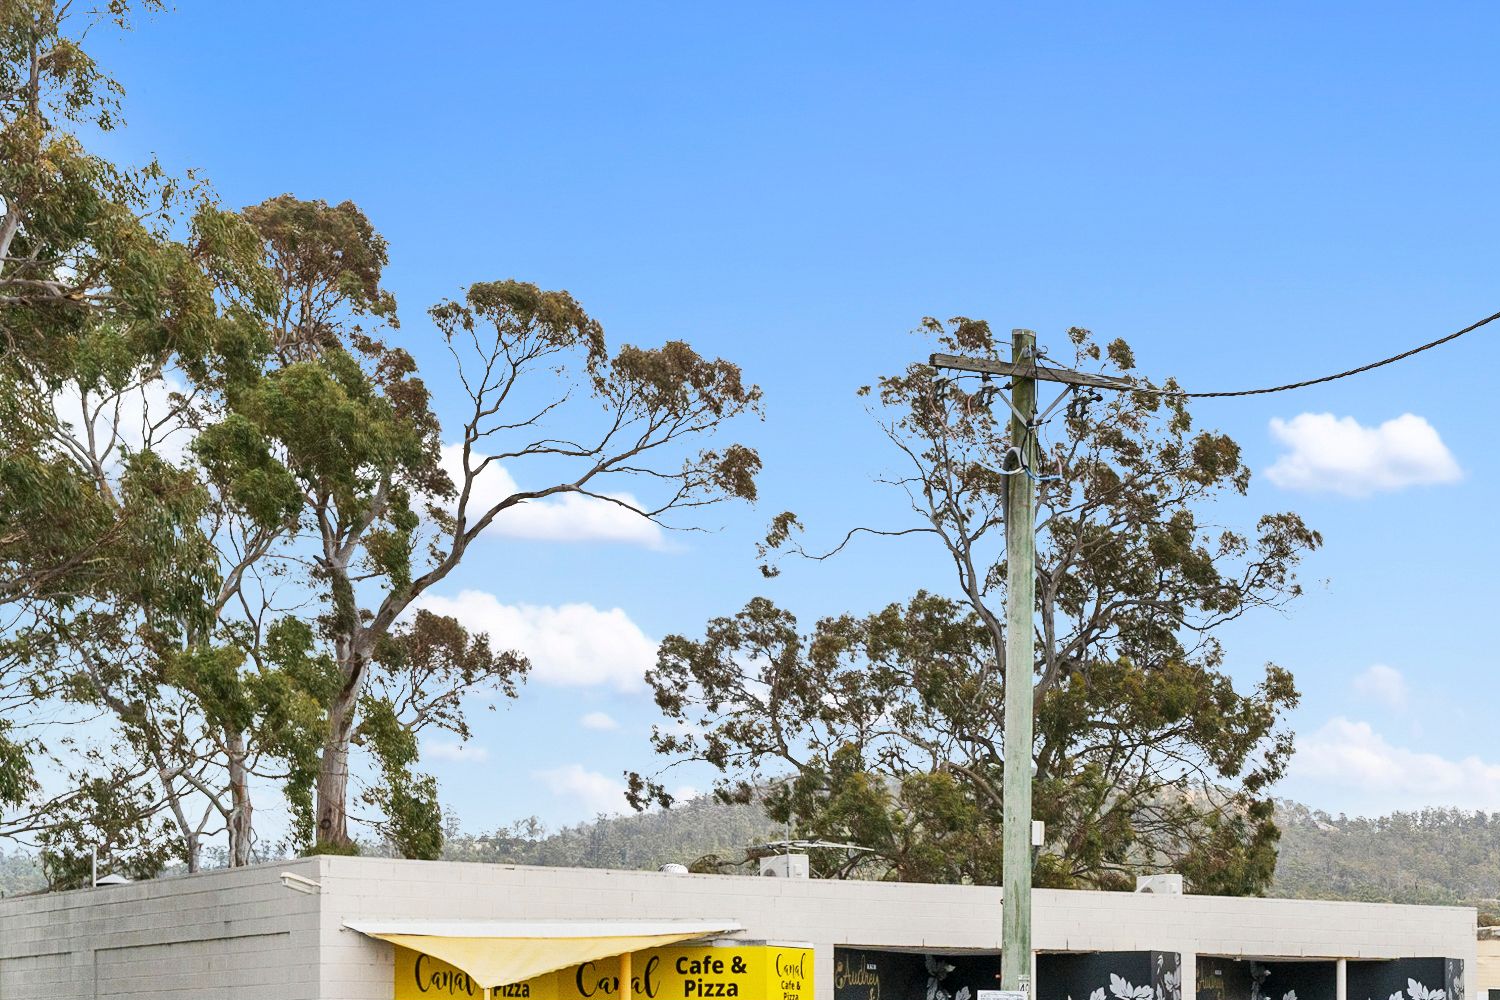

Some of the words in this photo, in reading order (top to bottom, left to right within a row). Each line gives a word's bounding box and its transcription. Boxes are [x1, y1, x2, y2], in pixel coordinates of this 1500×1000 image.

[675, 954, 725, 975] Cafe
[731, 955, 748, 975] &
[775, 952, 806, 980] Canal
[493, 982, 530, 999] Pizza
[684, 978, 739, 998] Pizza
[780, 980, 796, 991] Cafe
[796, 980, 801, 990] &
